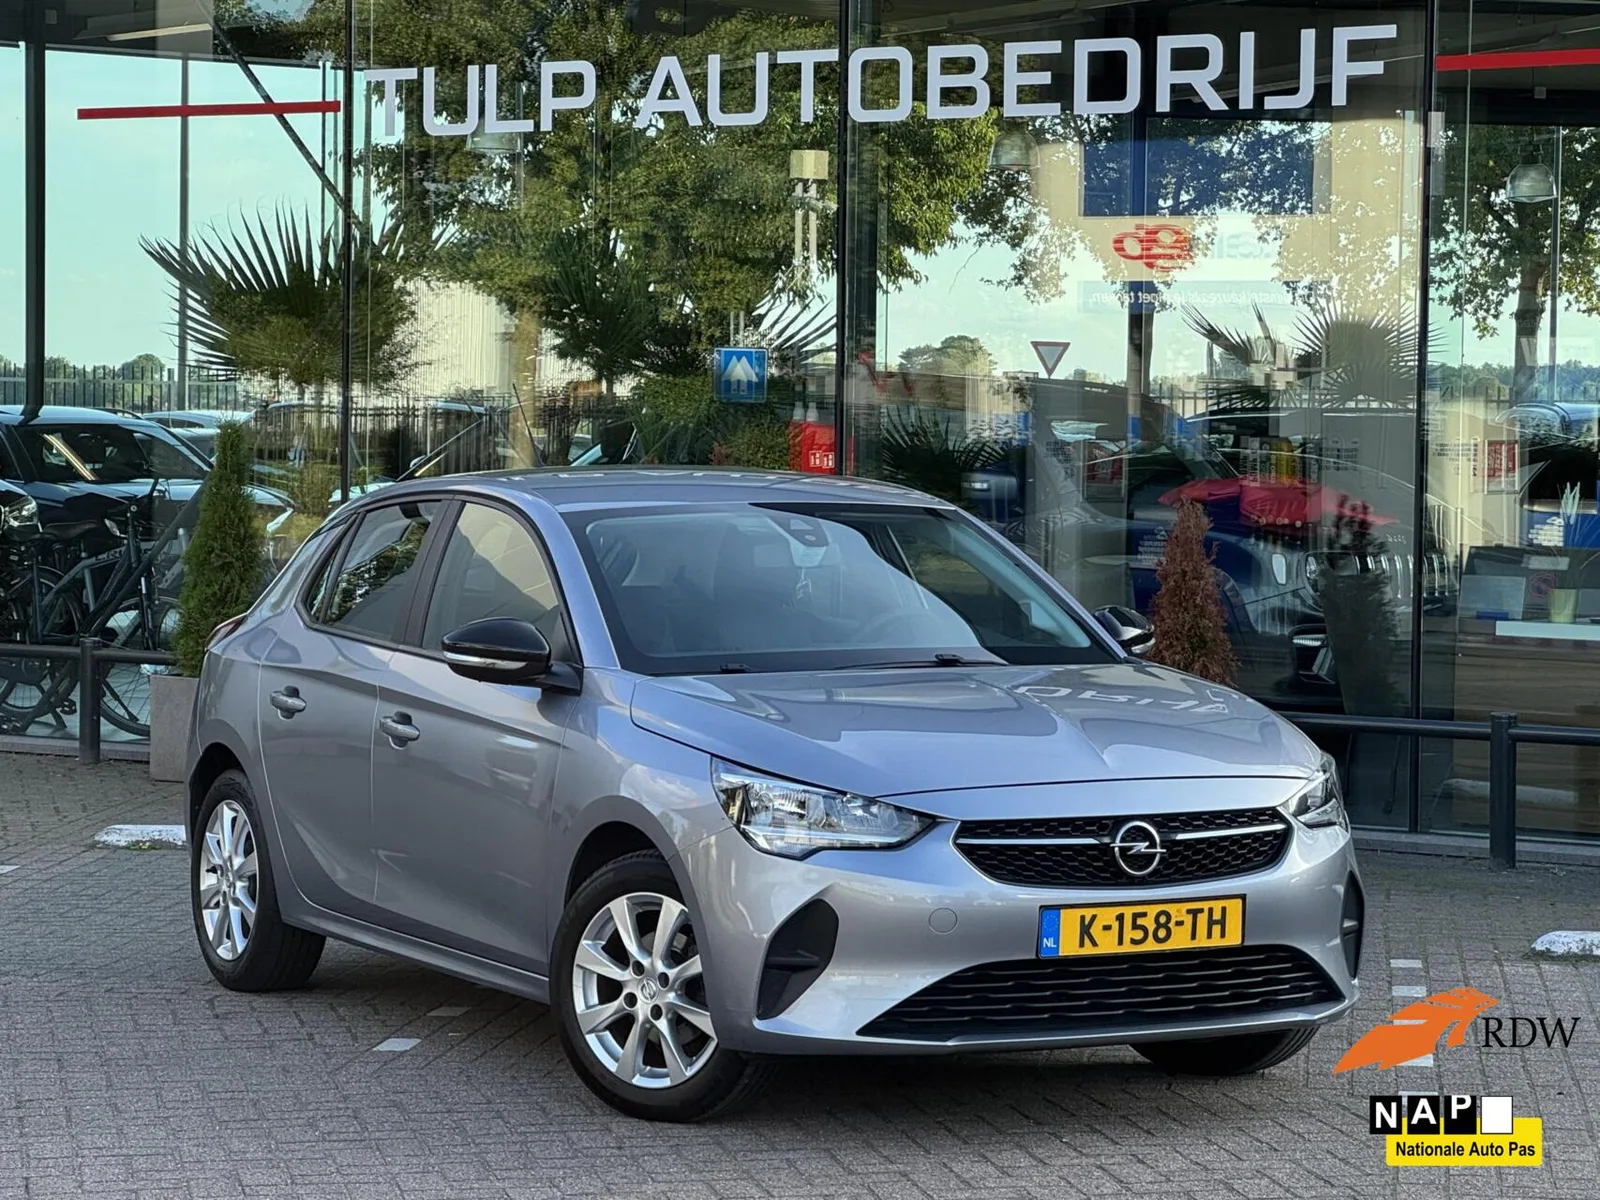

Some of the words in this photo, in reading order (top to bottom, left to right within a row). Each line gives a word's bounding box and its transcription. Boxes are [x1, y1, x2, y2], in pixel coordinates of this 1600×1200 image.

[364, 59, 597, 137] TULP
[633, 24, 1398, 128] AUTOBEDRIJF
[1043, 938, 1057, 948] NL
[1079, 906, 1227, 948] K-158-TH
